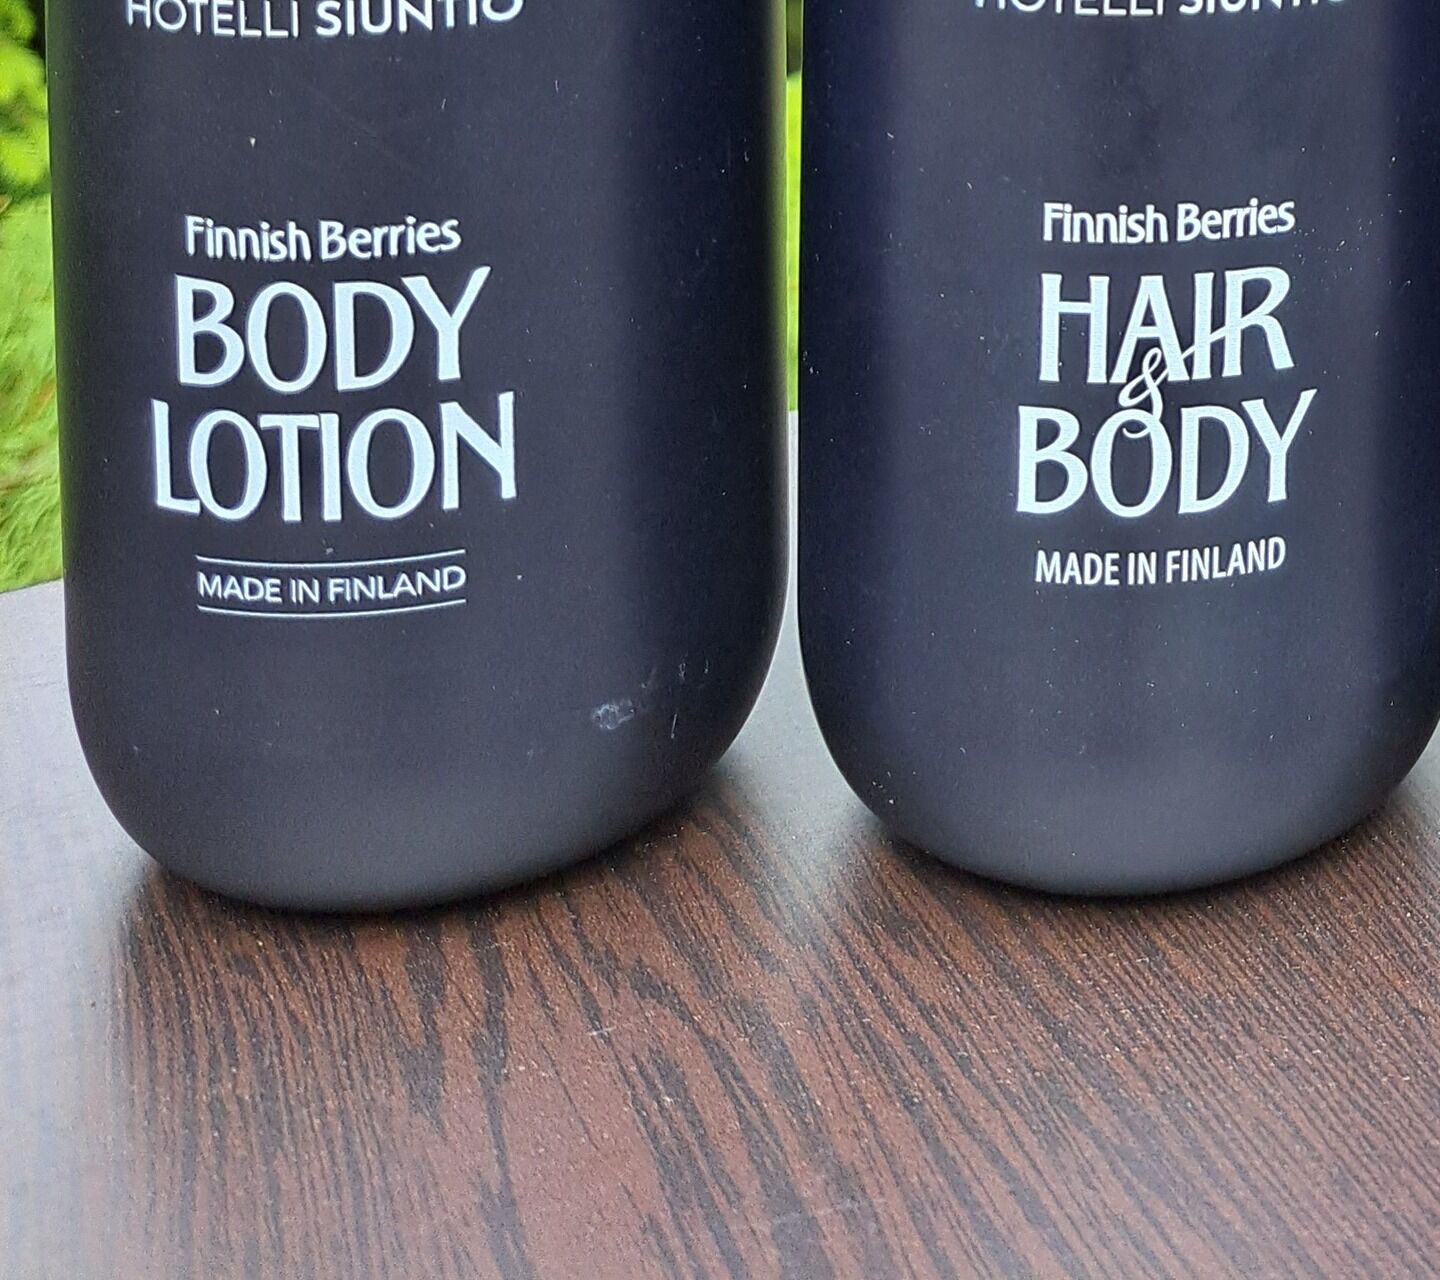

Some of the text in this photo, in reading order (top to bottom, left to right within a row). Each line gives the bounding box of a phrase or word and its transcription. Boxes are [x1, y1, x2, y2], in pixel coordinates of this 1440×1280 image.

[184, 214, 462, 263] Finnish Berries
[1042, 197, 1296, 245] Finnish Berries
[173, 265, 492, 395] BODY
[1038, 266, 1295, 386] HAIR
[150, 389, 518, 524] LOTION
[1014, 386, 1318, 520] BODY
[196, 563, 467, 605] MADE IN FINLAND
[1034, 536, 1287, 587] MADE IN FINLAND
